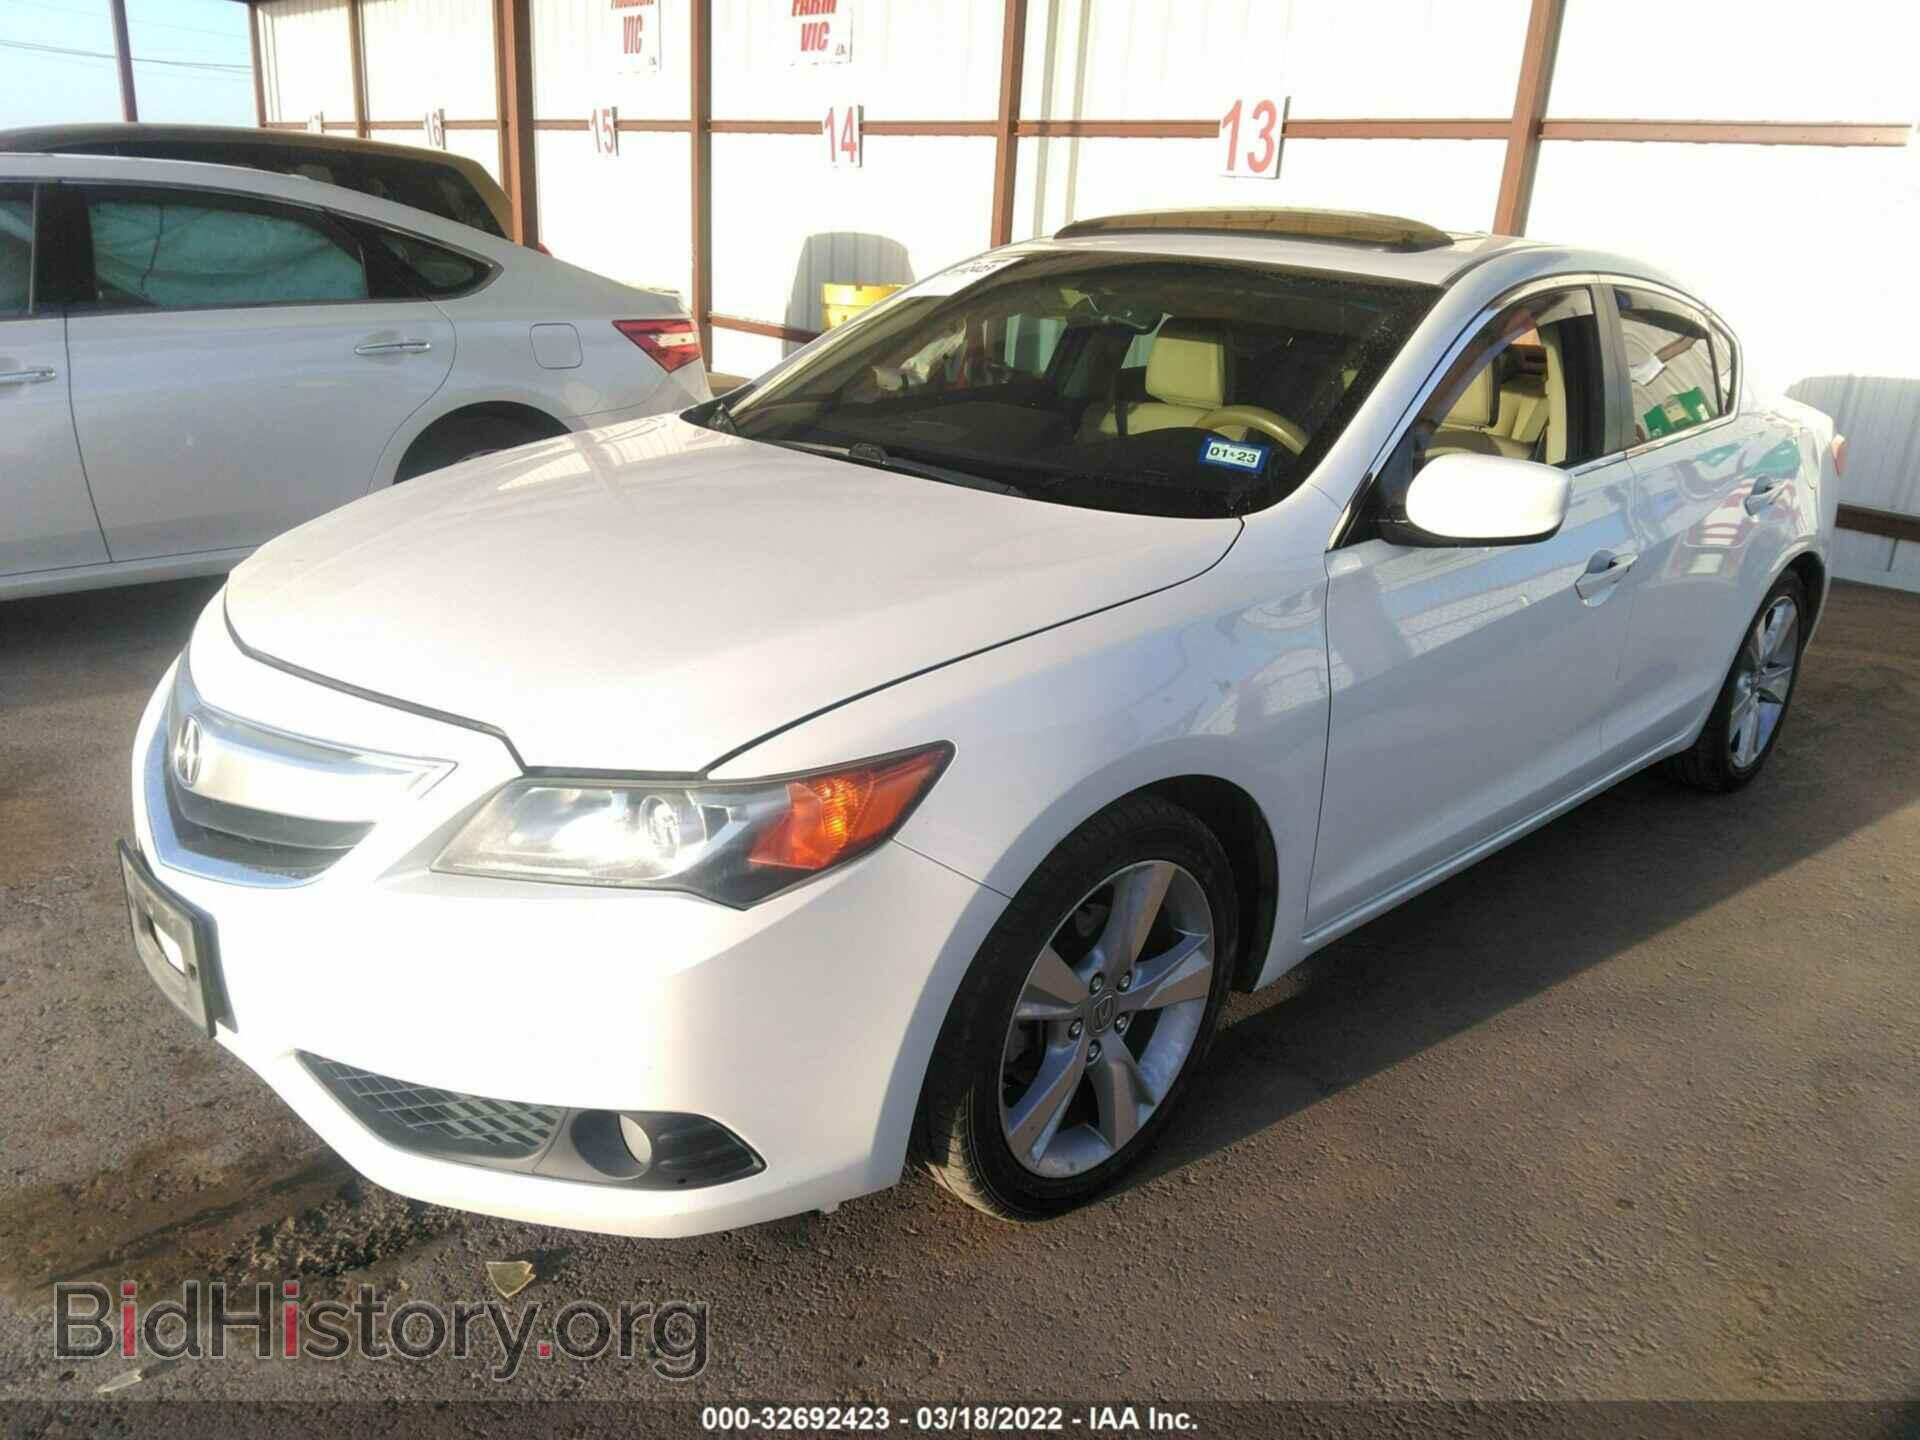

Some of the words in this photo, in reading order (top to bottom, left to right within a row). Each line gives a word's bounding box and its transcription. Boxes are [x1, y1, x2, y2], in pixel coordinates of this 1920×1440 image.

[624, 14, 642, 54] VIC
[801, 21, 829, 51] VIC
[590, 108, 613, 154] 15
[824, 106, 857, 163] 14
[1222, 99, 1276, 173] 13
